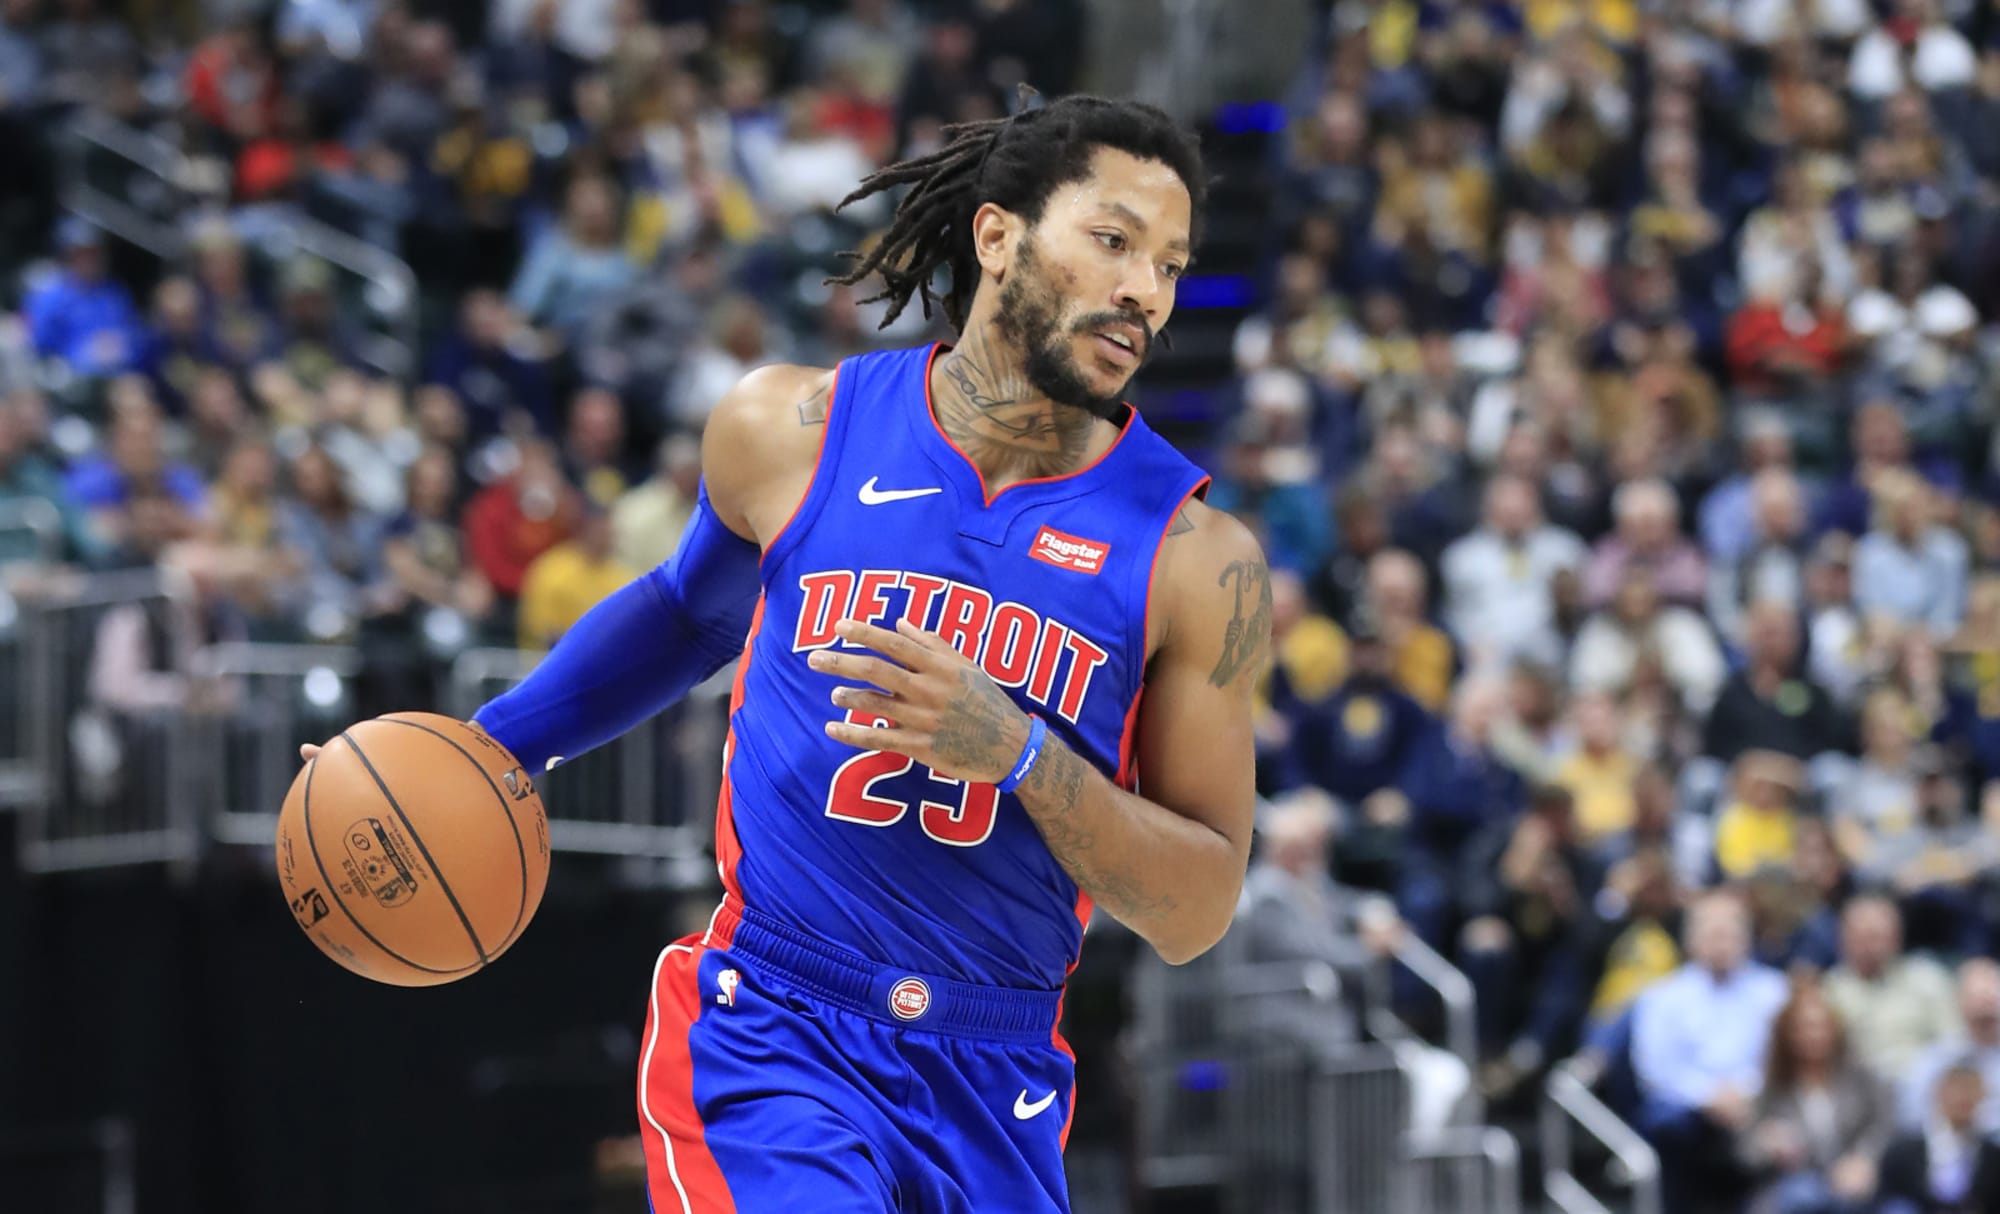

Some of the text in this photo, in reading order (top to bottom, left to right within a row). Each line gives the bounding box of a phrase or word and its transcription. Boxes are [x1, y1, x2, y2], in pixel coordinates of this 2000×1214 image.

[1039, 532, 1103, 560] Flagstar
[1073, 558, 1097, 570] Bank
[792, 569, 1109, 725] DETROIT
